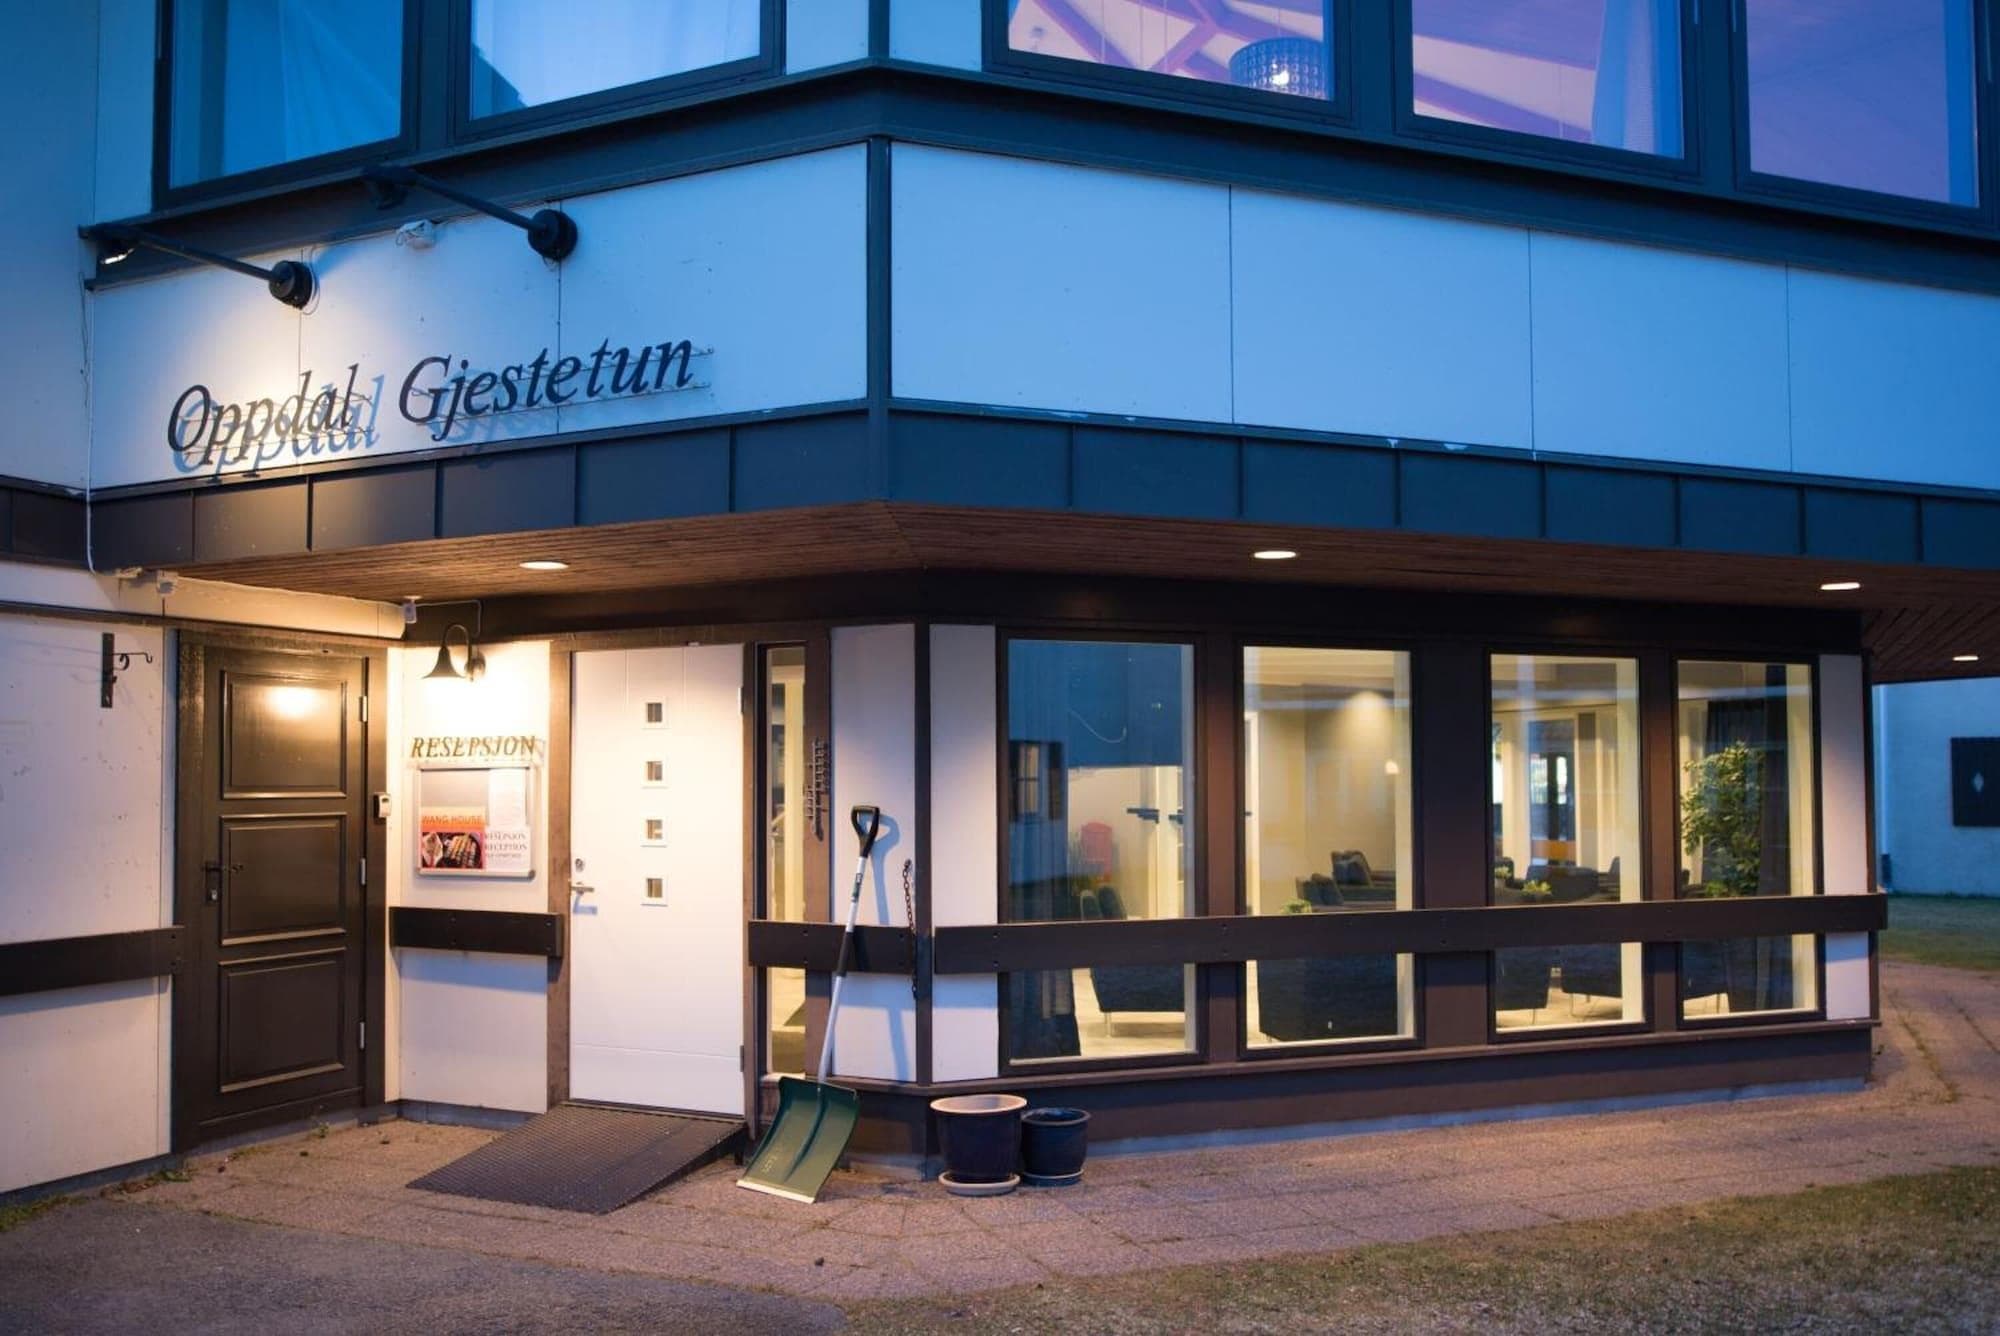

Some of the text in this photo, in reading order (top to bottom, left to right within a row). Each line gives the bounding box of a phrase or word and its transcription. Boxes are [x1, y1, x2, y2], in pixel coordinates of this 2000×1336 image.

[167, 338, 693, 465] Oppdal Gjestetun
[411, 736, 535, 758] RESEPSJON
